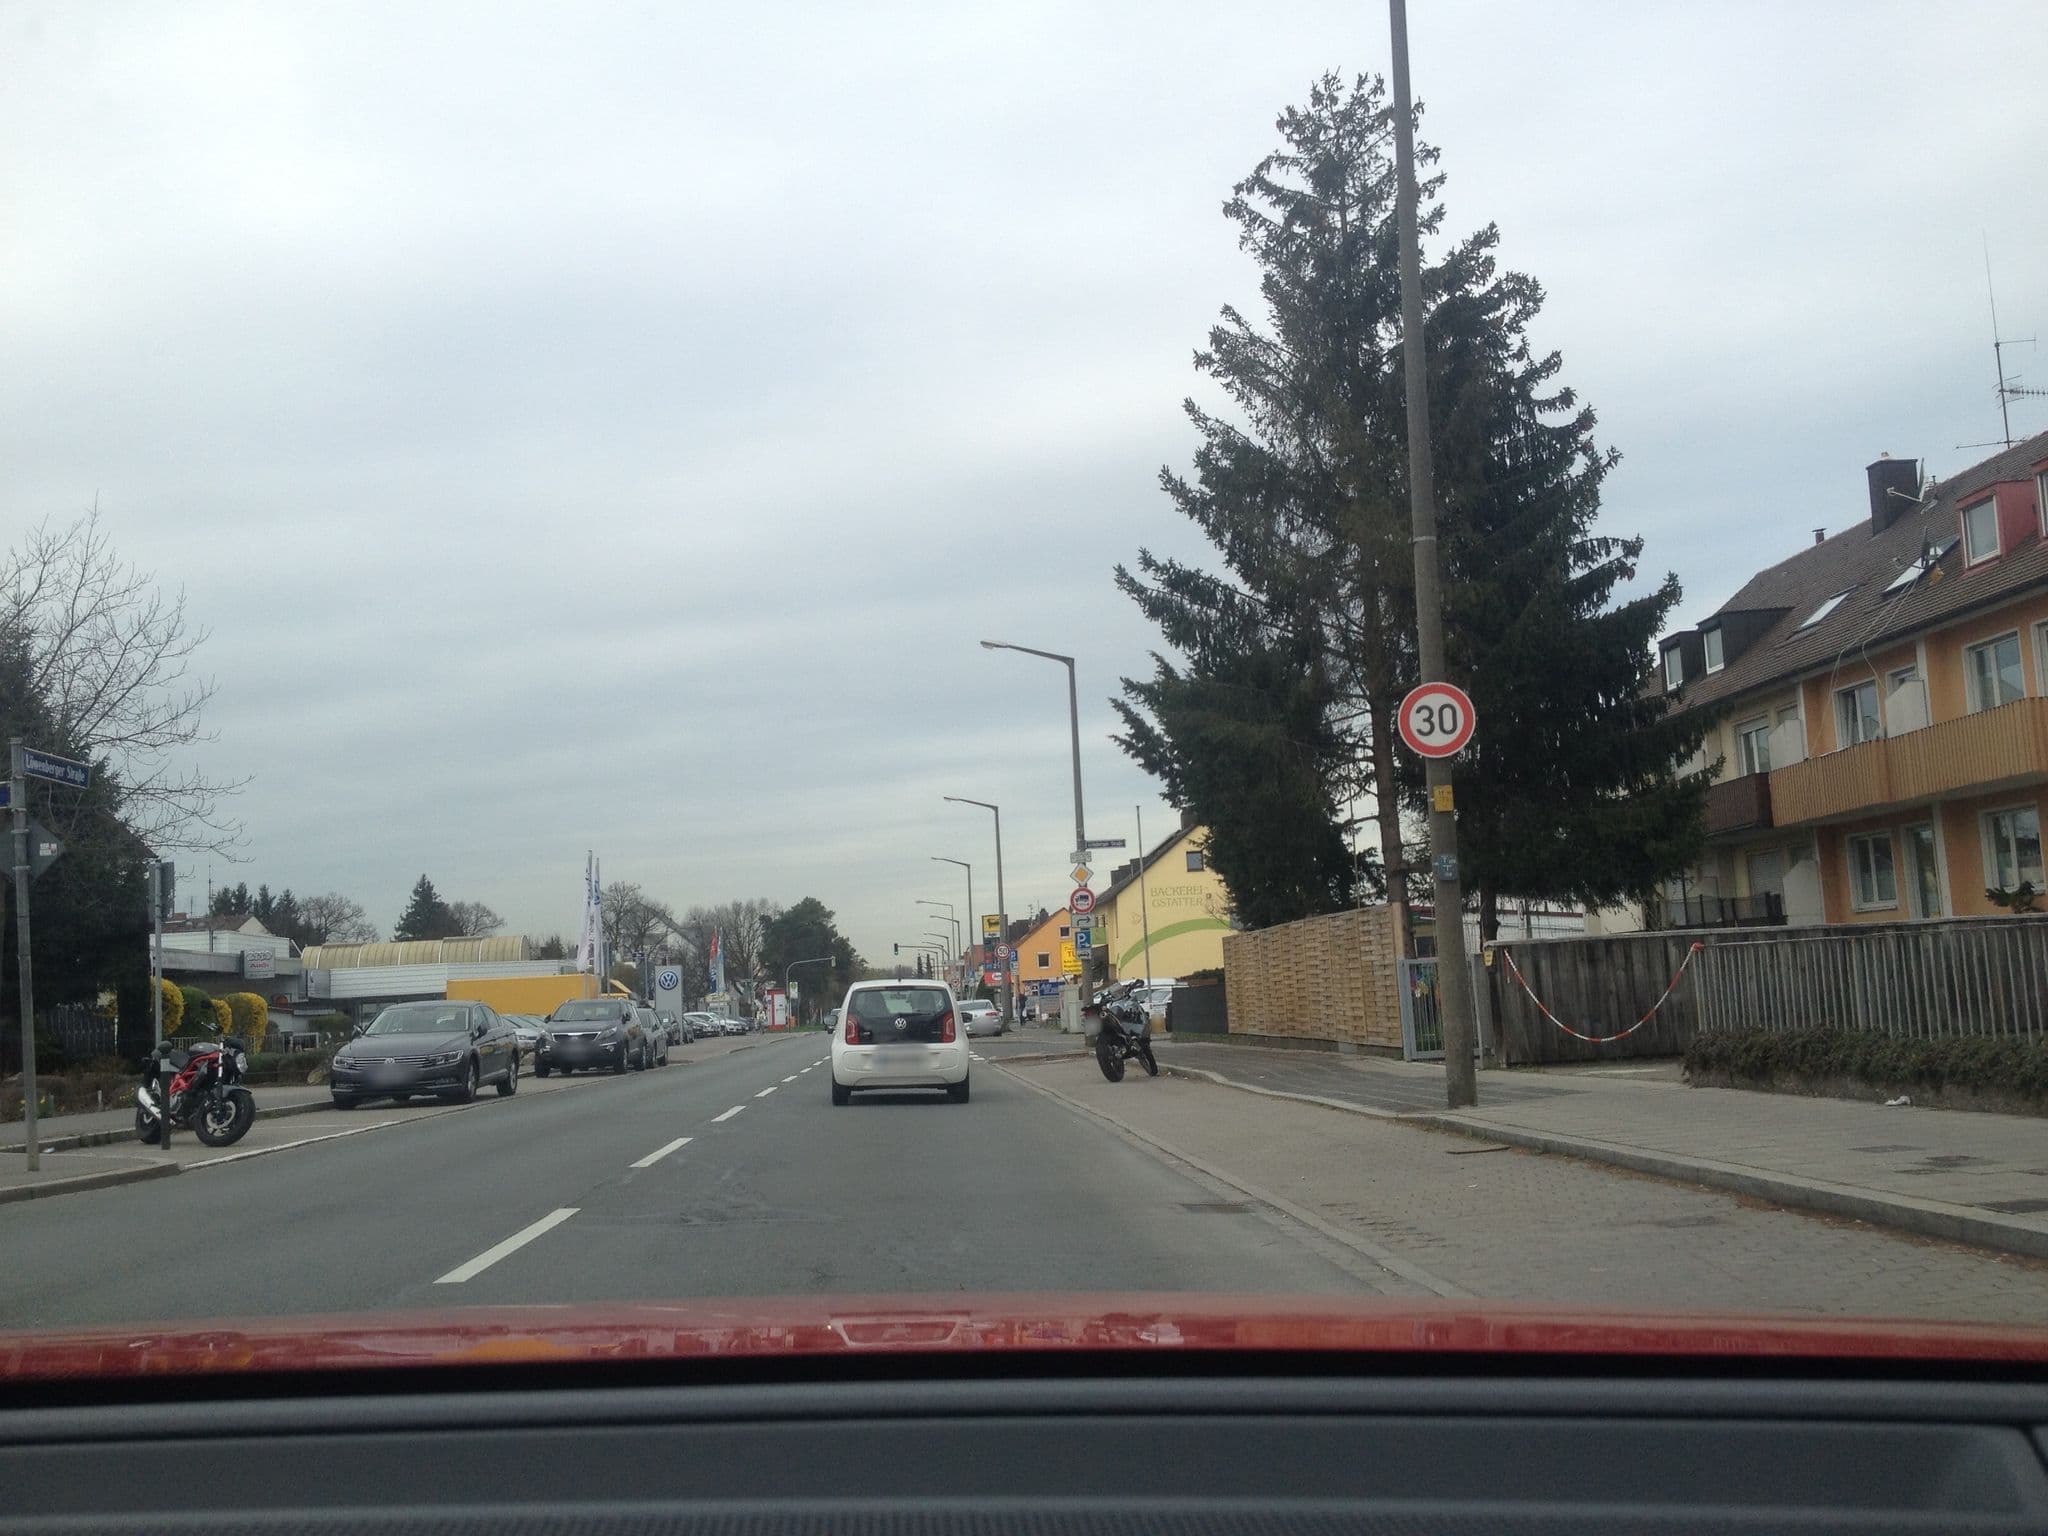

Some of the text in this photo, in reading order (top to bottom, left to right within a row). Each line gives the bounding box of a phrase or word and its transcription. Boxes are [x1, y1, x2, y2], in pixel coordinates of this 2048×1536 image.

[1415, 703, 1458, 737] 30
[66, 765, 85, 784] Straße
[998, 947, 1008, 956] 50
